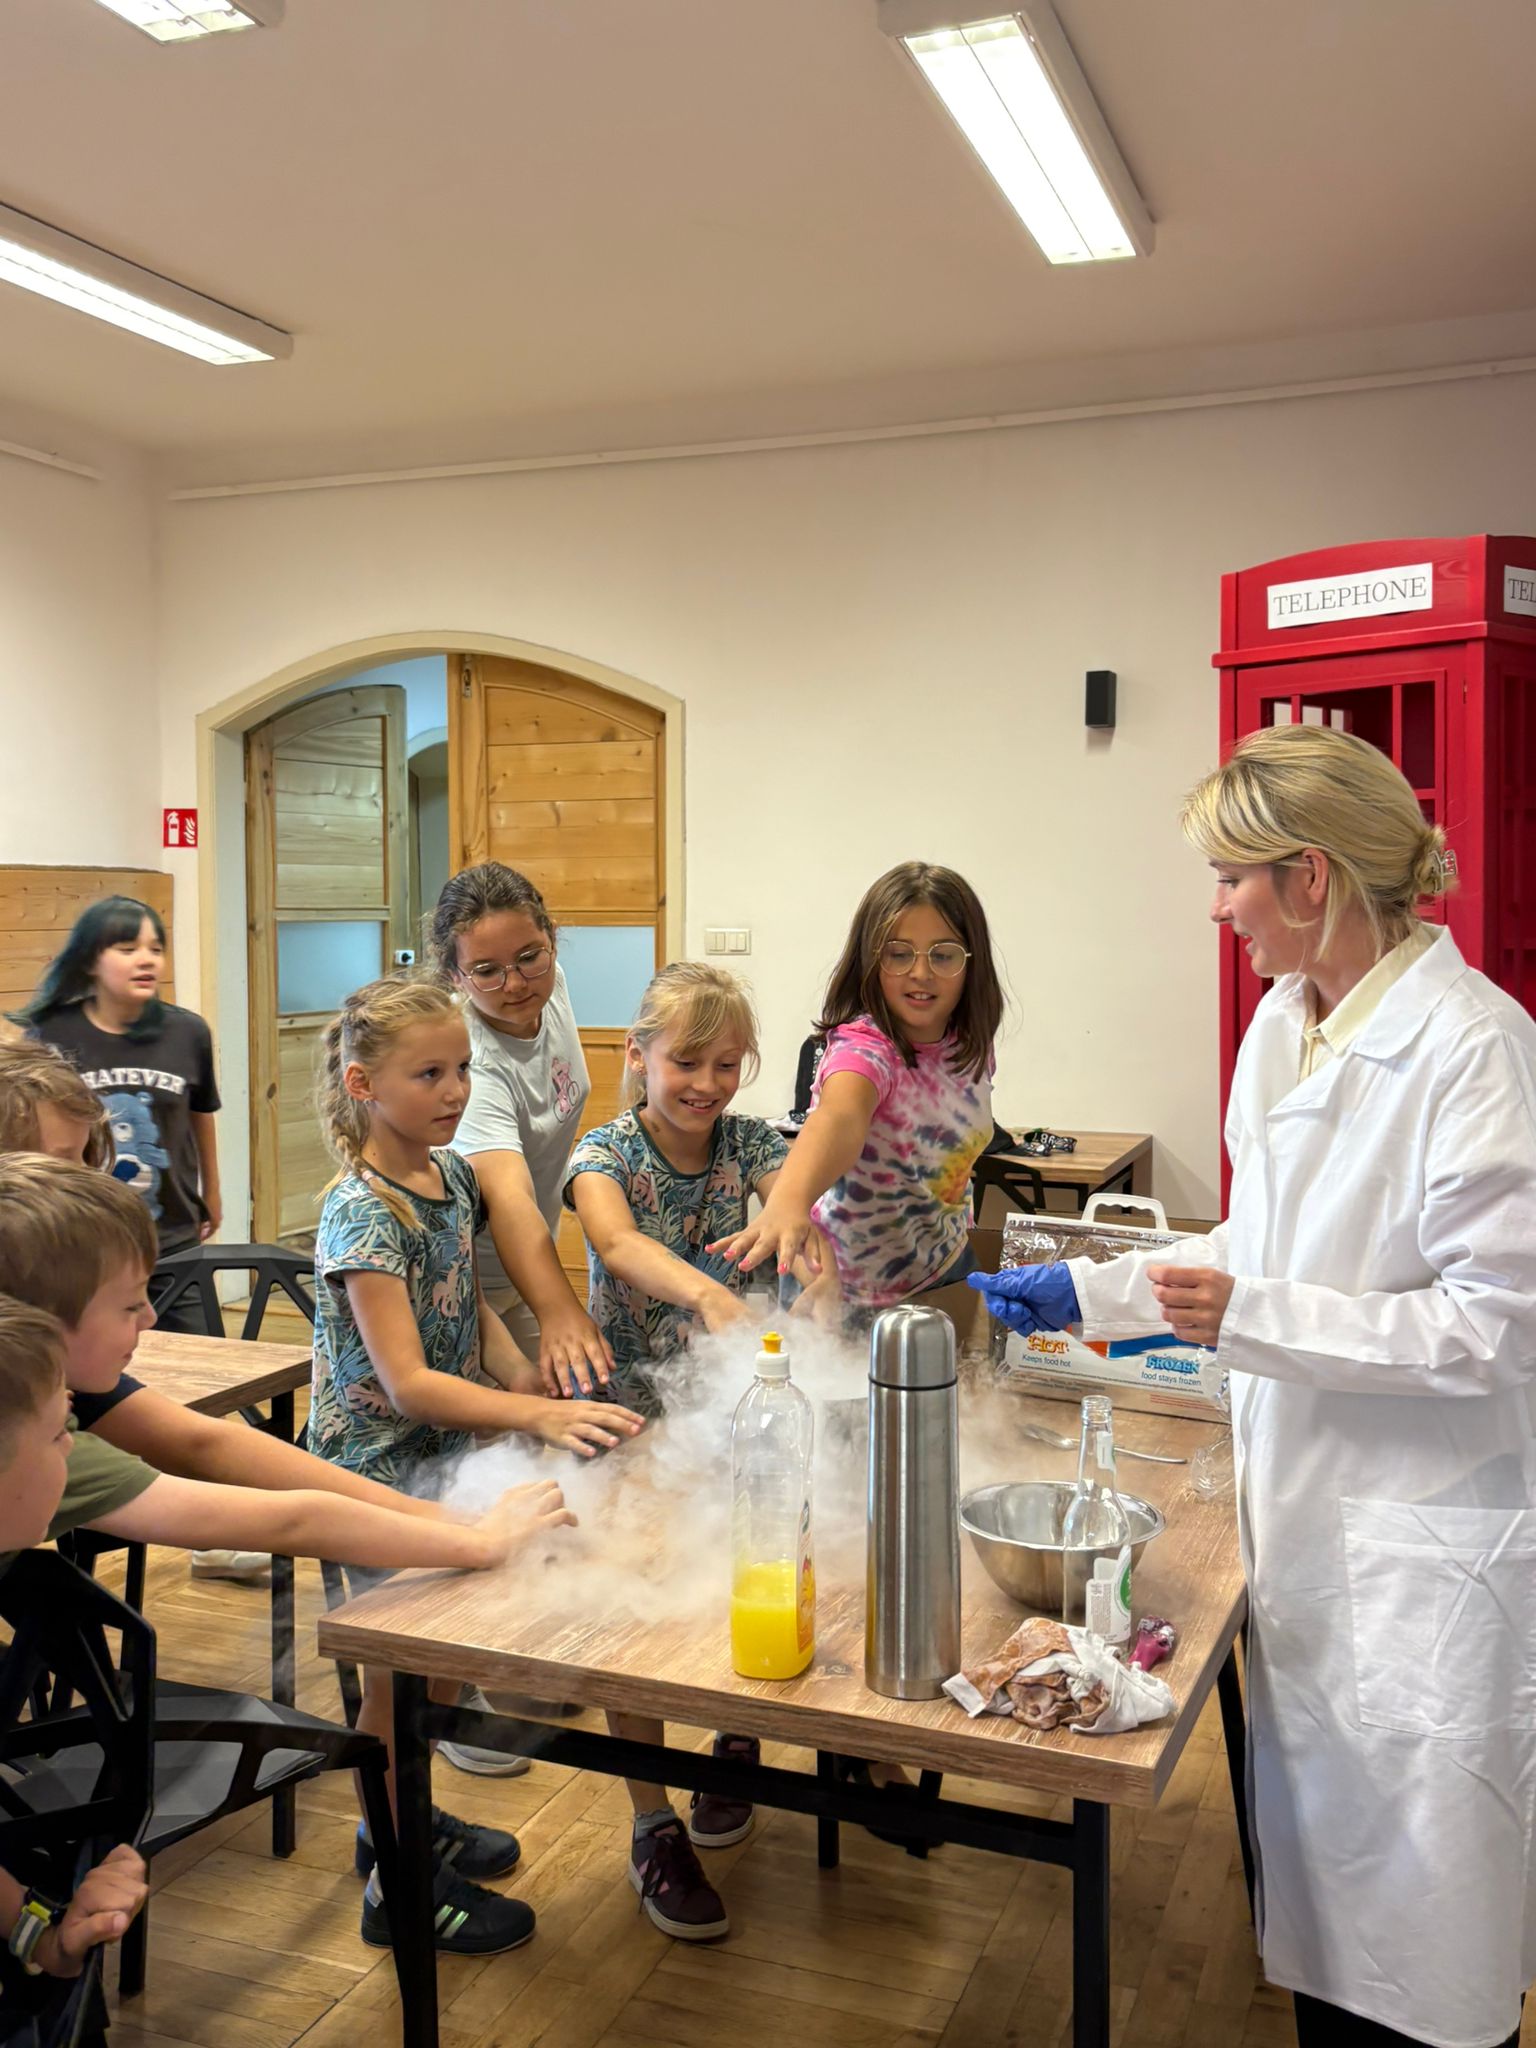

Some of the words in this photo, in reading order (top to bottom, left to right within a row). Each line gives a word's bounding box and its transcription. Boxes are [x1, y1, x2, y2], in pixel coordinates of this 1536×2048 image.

[1273, 577, 1427, 616] TELEPHONE
[1508, 578, 1536, 603] TEL
[80, 1067, 186, 1095] HATEVER
[1022, 1354, 1043, 1364] Keeps
[1044, 1356, 1059, 1366] food
[1060, 1358, 1071, 1368] hot
[1146, 1354, 1200, 1374] FROZEN
[1141, 1371, 1157, 1380] food
[1159, 1373, 1177, 1384] stays
[1178, 1376, 1202, 1386] frozen
